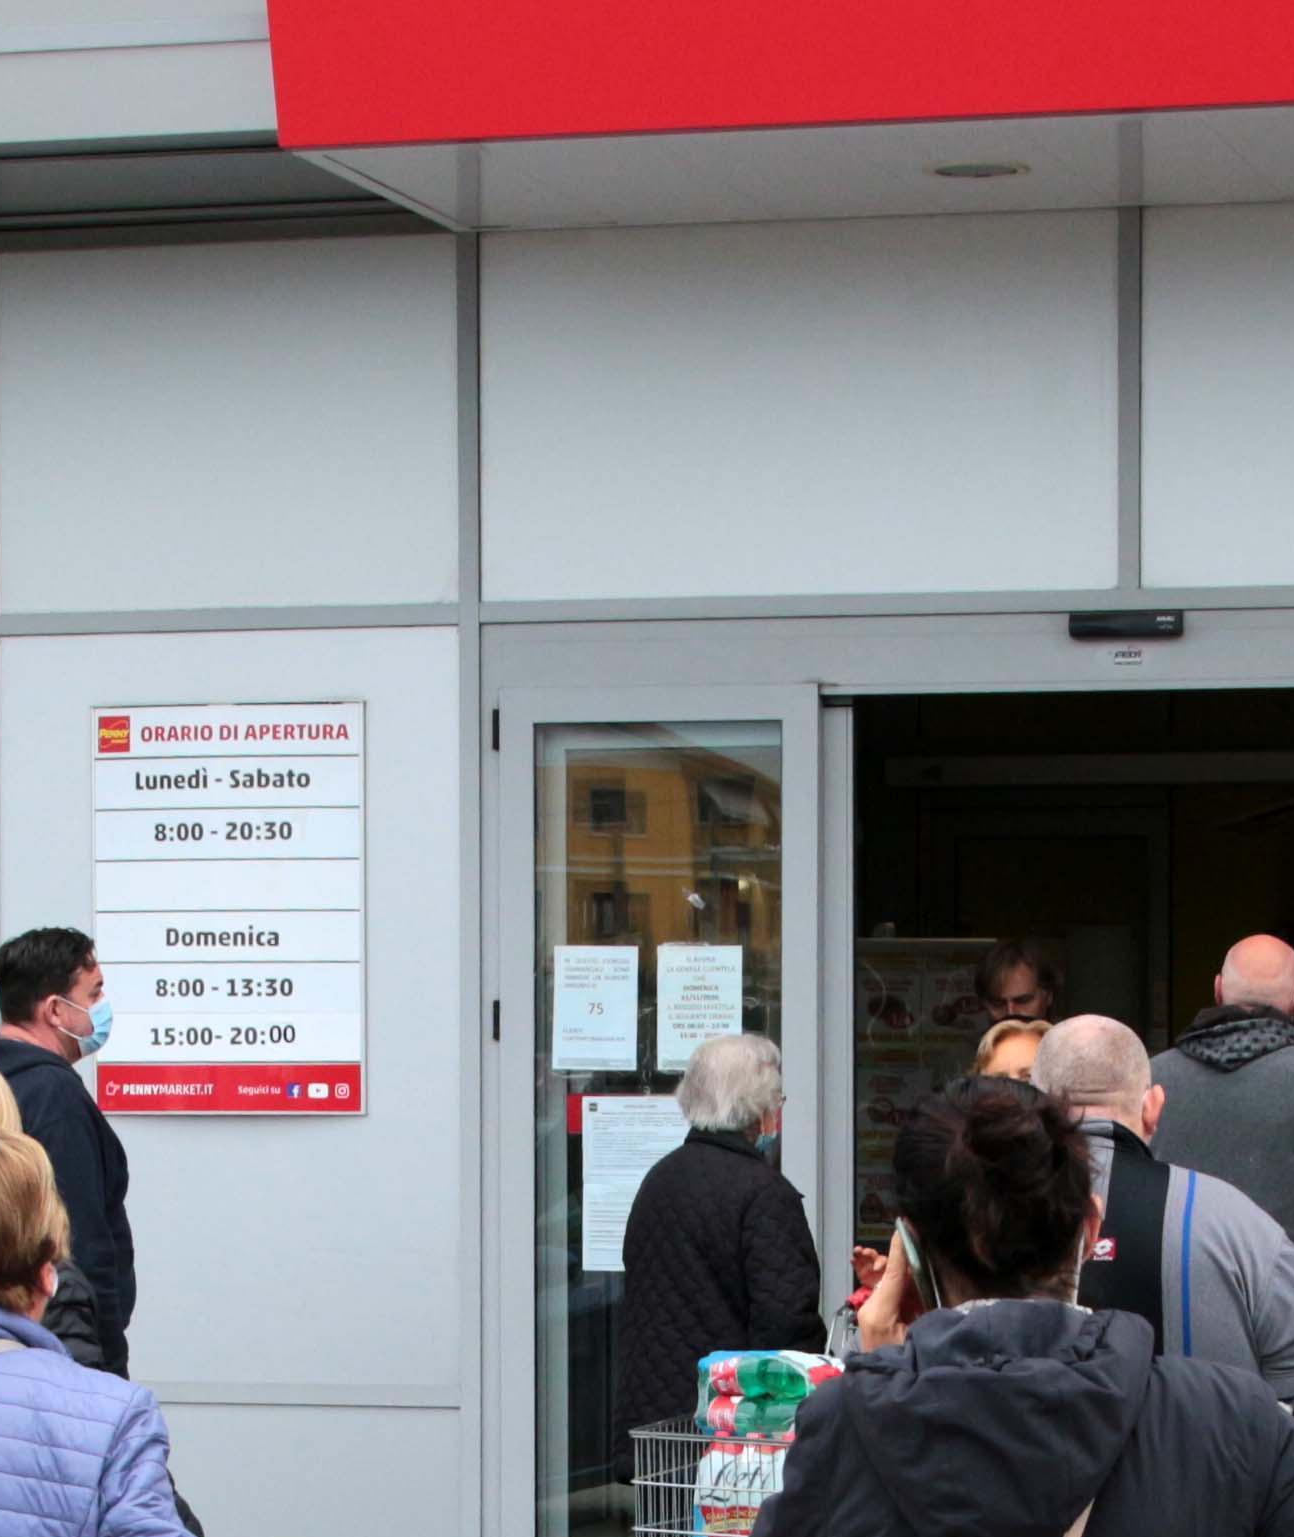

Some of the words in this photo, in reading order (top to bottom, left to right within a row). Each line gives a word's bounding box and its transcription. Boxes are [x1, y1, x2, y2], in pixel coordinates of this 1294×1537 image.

[140, 725, 214, 742] ORARIO
[219, 724, 239, 741] DI
[244, 723, 349, 741] APERTURA
[134, 766, 209, 791] Lunedì
[228, 768, 311, 789] Sabato
[153, 823, 204, 842] 8:00
[224, 821, 293, 841] 20:30
[165, 925, 280, 948] Domenica
[155, 979, 205, 998] 8:00
[226, 978, 294, 997] 13:30
[588, 1002, 604, 1016] 75
[229, 1024, 296, 1047] 20:00
[122, 1083, 214, 1095] PENNYMARKET.IT
[237, 1084, 270, 1096] Seguici
[270, 1086, 281, 1095] su
